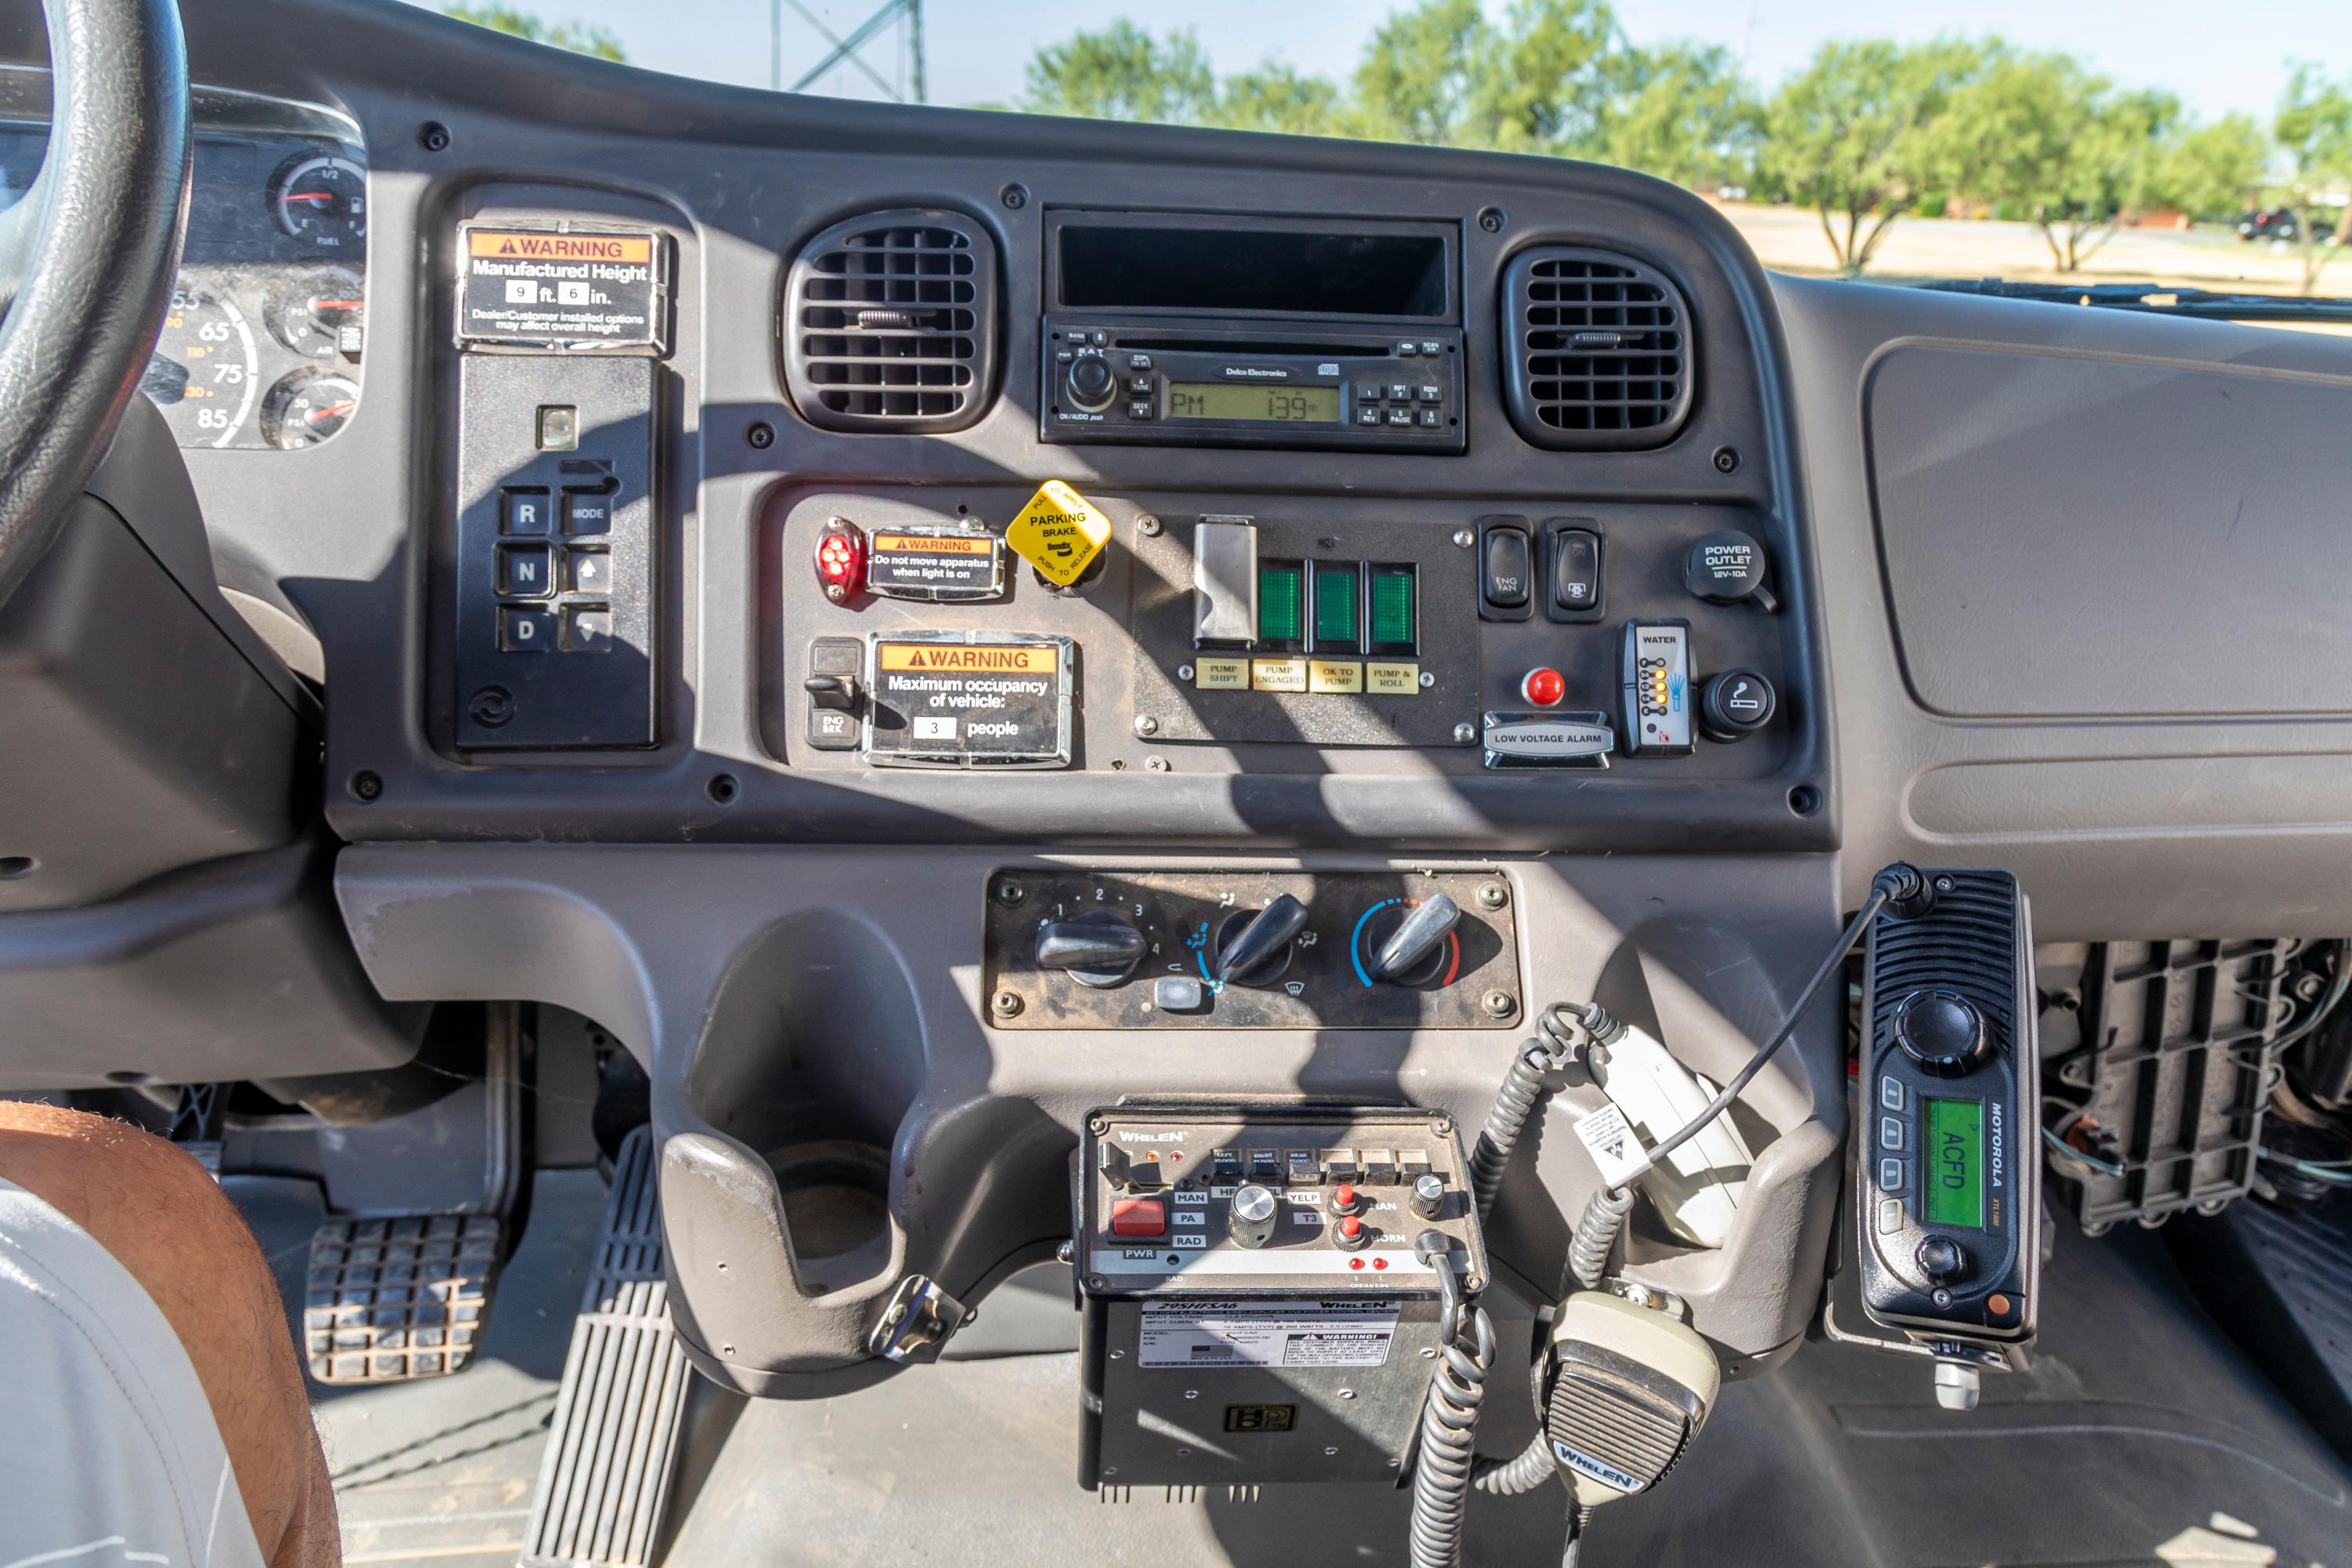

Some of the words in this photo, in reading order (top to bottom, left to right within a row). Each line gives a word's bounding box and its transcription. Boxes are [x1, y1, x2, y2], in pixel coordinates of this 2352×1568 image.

[321, 169, 339, 180] 1/2
[301, 219, 309, 228] E
[349, 220, 356, 229] F
[317, 237, 339, 246] FUEL
[520, 238, 622, 258] WARNING
[472, 260, 590, 279] Manufactured
[592, 264, 648, 284] Height
[170, 290, 201, 310] 55
[517, 287, 525, 297] 9
[539, 287, 557, 303] ft.
[569, 288, 578, 298] 6
[590, 289, 612, 304] in.
[291, 308, 308, 317] PSI
[561, 312, 604, 324] installed
[605, 314, 644, 325] options
[198, 321, 230, 342] 65
[495, 321, 518, 331] may
[520, 321, 550, 331] affect
[551, 321, 586, 332] overall
[587, 322, 621, 335] height
[187, 347, 206, 358] 110
[316, 346, 334, 354] AIR
[213, 363, 243, 384] 75
[1226, 368, 1247, 376] Delco
[1248, 368, 1287, 378] Electronics
[293, 398, 310, 408] 50
[1171, 394, 1205, 416] PM
[198, 408, 228, 429] 85
[288, 419, 306, 428] PSI
[1033, 495, 1048, 510] PULL
[1063, 493, 1083, 508] APPLY
[519, 504, 535, 523] R
[572, 508, 604, 519] MODE
[1030, 512, 1086, 526] PARKING
[1042, 527, 1077, 538] BRAKE
[908, 539, 971, 551] WARNING
[1047, 541, 1072, 551] Bendix
[1704, 545, 1751, 556] POWER
[874, 554, 890, 564] Do
[891, 556, 909, 565] not
[909, 557, 938, 566] move
[938, 557, 989, 568] apparatus
[1036, 555, 1056, 572] PUSH
[1069, 542, 1094, 569] RELEASE
[1705, 555, 1752, 565] OUTLET
[519, 562, 535, 581] N
[892, 567, 920, 577] when
[921, 568, 945, 580] light
[946, 568, 956, 579] is
[956, 570, 971, 579] on
[1713, 570, 1748, 579] 12V-10A
[1495, 576, 1518, 586] ENG
[518, 621, 534, 640] D
[929, 651, 1029, 668] WARNING
[1374, 669, 1400, 677] PUMP
[888, 675, 963, 691] Maximum
[965, 678, 1048, 696] occupancy
[929, 693, 948, 708] of
[947, 693, 1006, 709] vehicle:
[822, 716, 844, 726] ENG
[822, 724, 843, 734] BRK
[930, 722, 938, 735] 3
[967, 720, 1019, 739] people
[1096, 888, 1104, 901] 2
[1058, 903, 1063, 916] 1
[1135, 904, 1143, 916] 3
[1152, 942, 1160, 955] 4
[1119, 1131, 1184, 1142] WHELEN
[1992, 1102, 2002, 1187] MOTOROLA
[1943, 1131, 1965, 1190] ACFD
[1370, 1202, 1397, 1210] MAN
[1370, 1234, 1406, 1243] HORN
[1560, 1446, 1632, 1487] WHELEN
